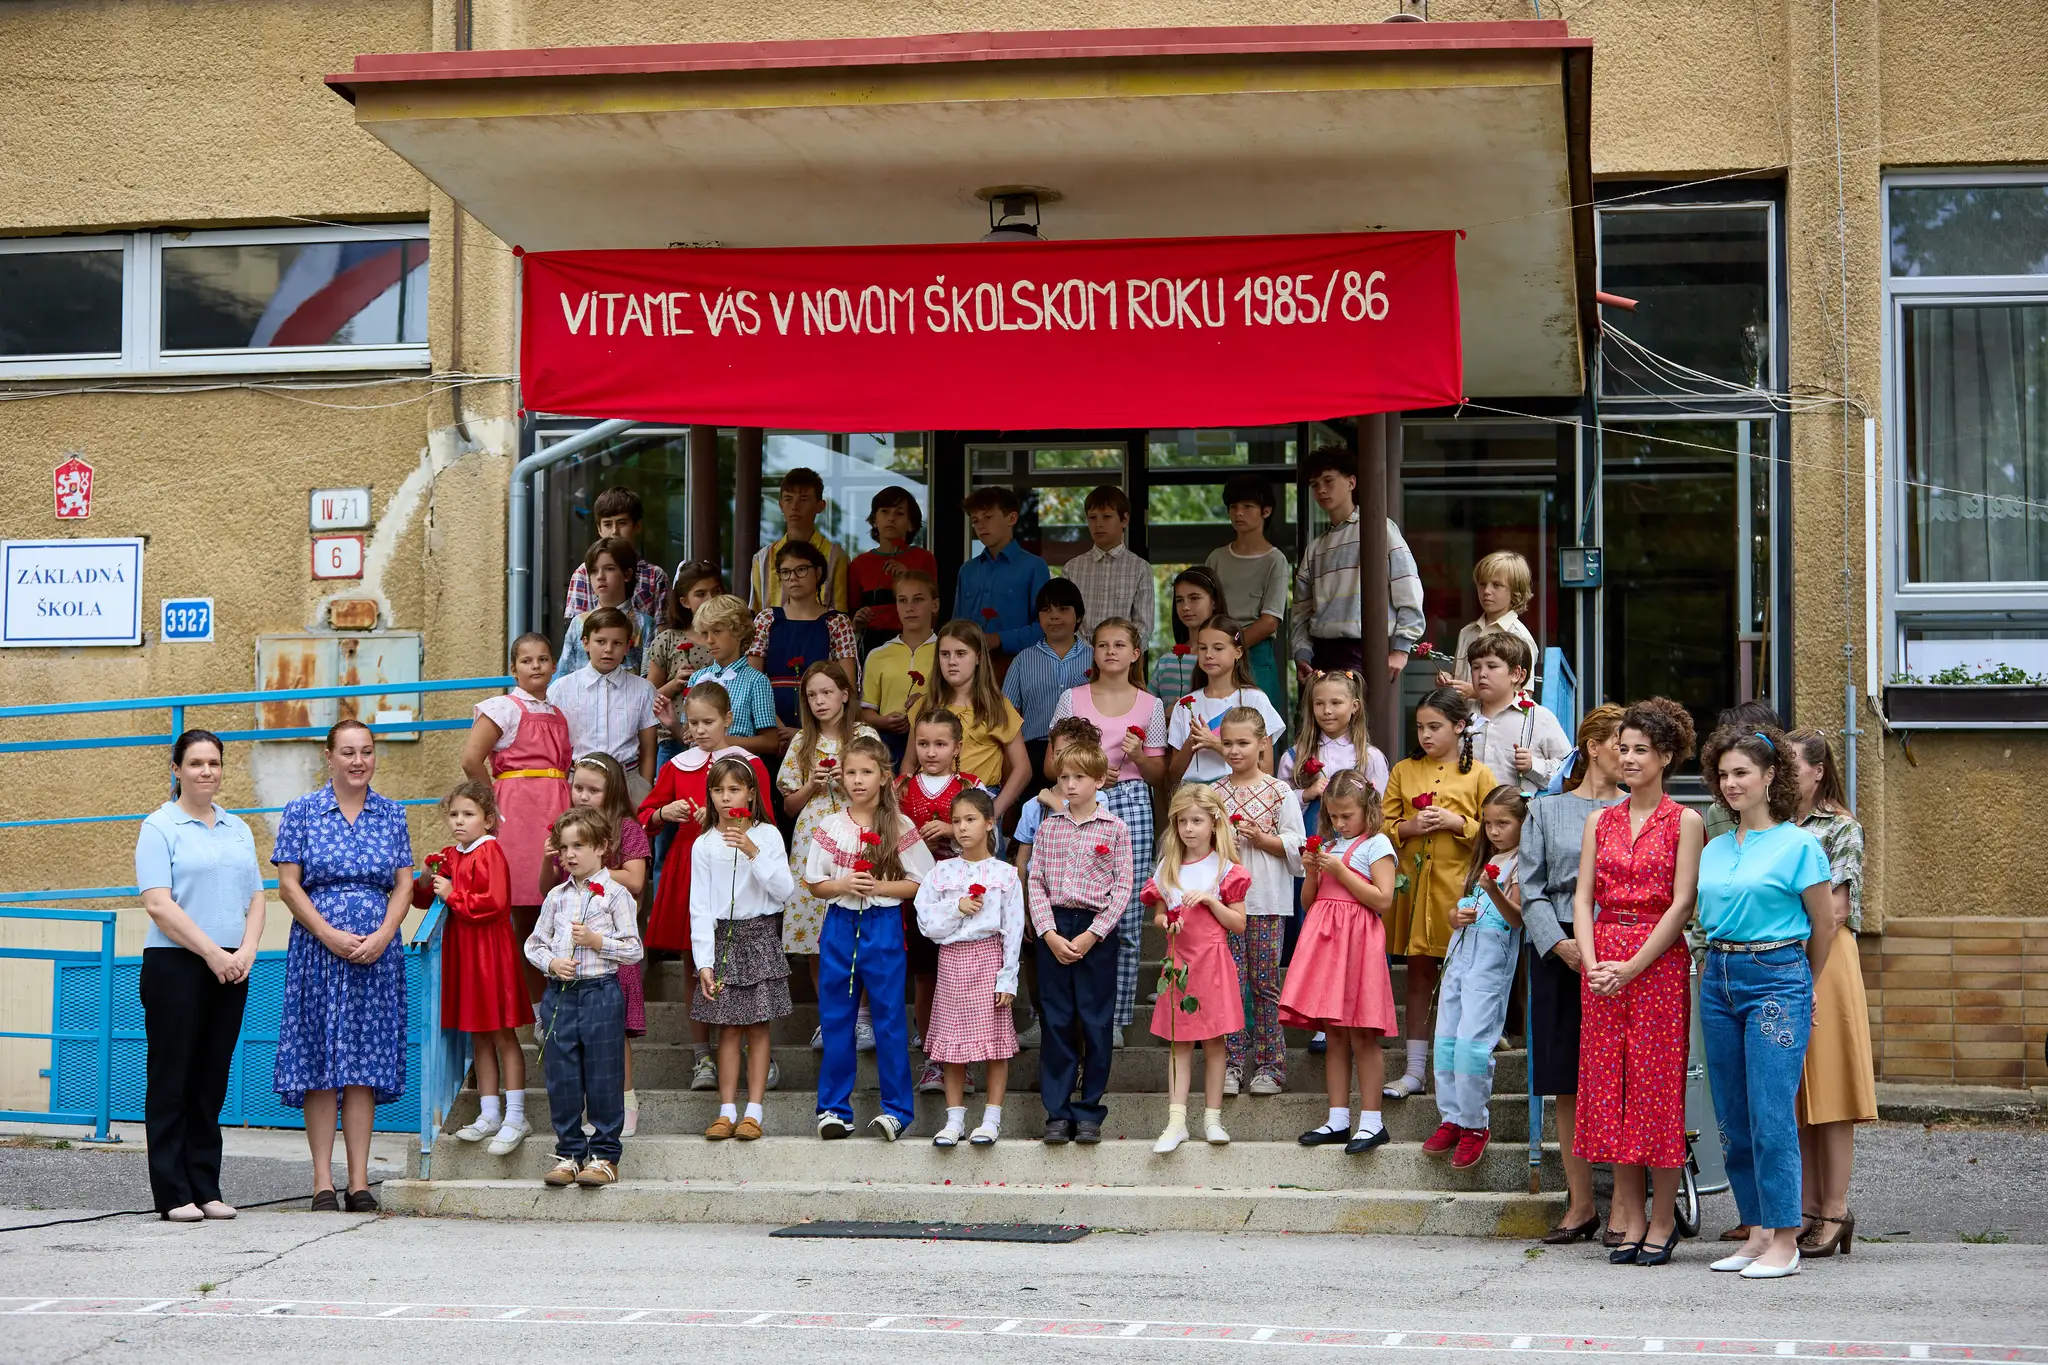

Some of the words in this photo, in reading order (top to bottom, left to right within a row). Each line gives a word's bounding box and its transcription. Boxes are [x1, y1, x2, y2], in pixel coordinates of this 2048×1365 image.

[699, 286, 761, 337] VÁS
[769, 291, 795, 336] V
[801, 284, 915, 336] NOVOM
[924, 274, 1118, 332] ŠKOLSKOM
[1127, 277, 1226, 330] ROKU
[1234, 269, 1390, 326] 1985/86
[332, 547, 342, 568] 6
[16, 563, 125, 585] ZÁKLADNÁ
[36, 597, 103, 617] ŠKOLA
[167, 608, 208, 632] 3327
[1032, 1321, 1105, 1334] 10
